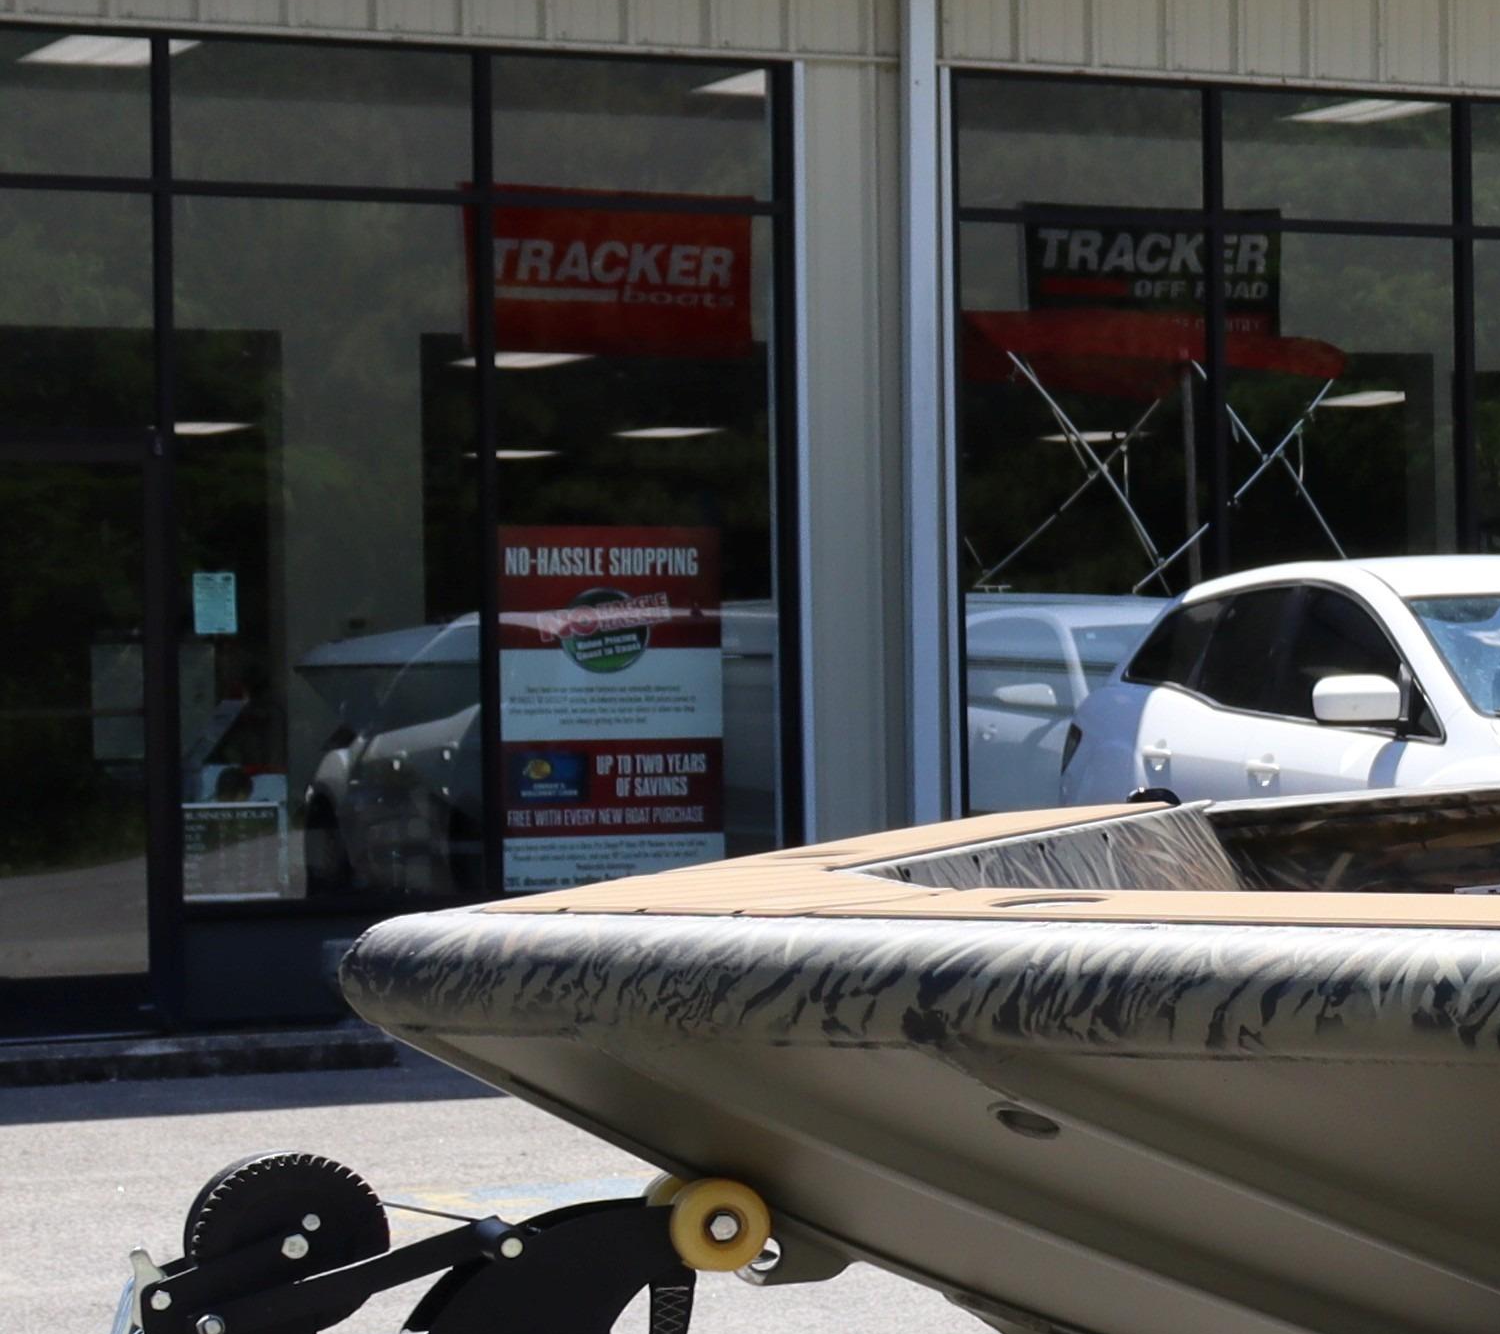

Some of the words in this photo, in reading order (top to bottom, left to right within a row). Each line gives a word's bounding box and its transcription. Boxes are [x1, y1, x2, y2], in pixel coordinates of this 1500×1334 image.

[494, 238, 736, 287] TRACKER
[1037, 228, 1269, 274] TRACKER
[622, 284, 736, 308] boats
[1134, 279, 1187, 299] OFF
[505, 546, 604, 576] NO-HASSLE
[609, 546, 699, 576] SHOPPING
[596, 755, 614, 775] UP
[617, 755, 632, 774] TO
[634, 754, 665, 774] TWO
[667, 753, 706, 773] YEARS
[616, 777, 633, 797] OF
[634, 776, 688, 796] SAVINGS
[507, 810, 532, 827] FREE
[534, 810, 562, 826] WITH
[563, 809, 596, 826] EVERY
[598, 808, 624, 825] NEW
[625, 807, 650, 824] BOAT
[652, 806, 704, 824] PURCHASE
